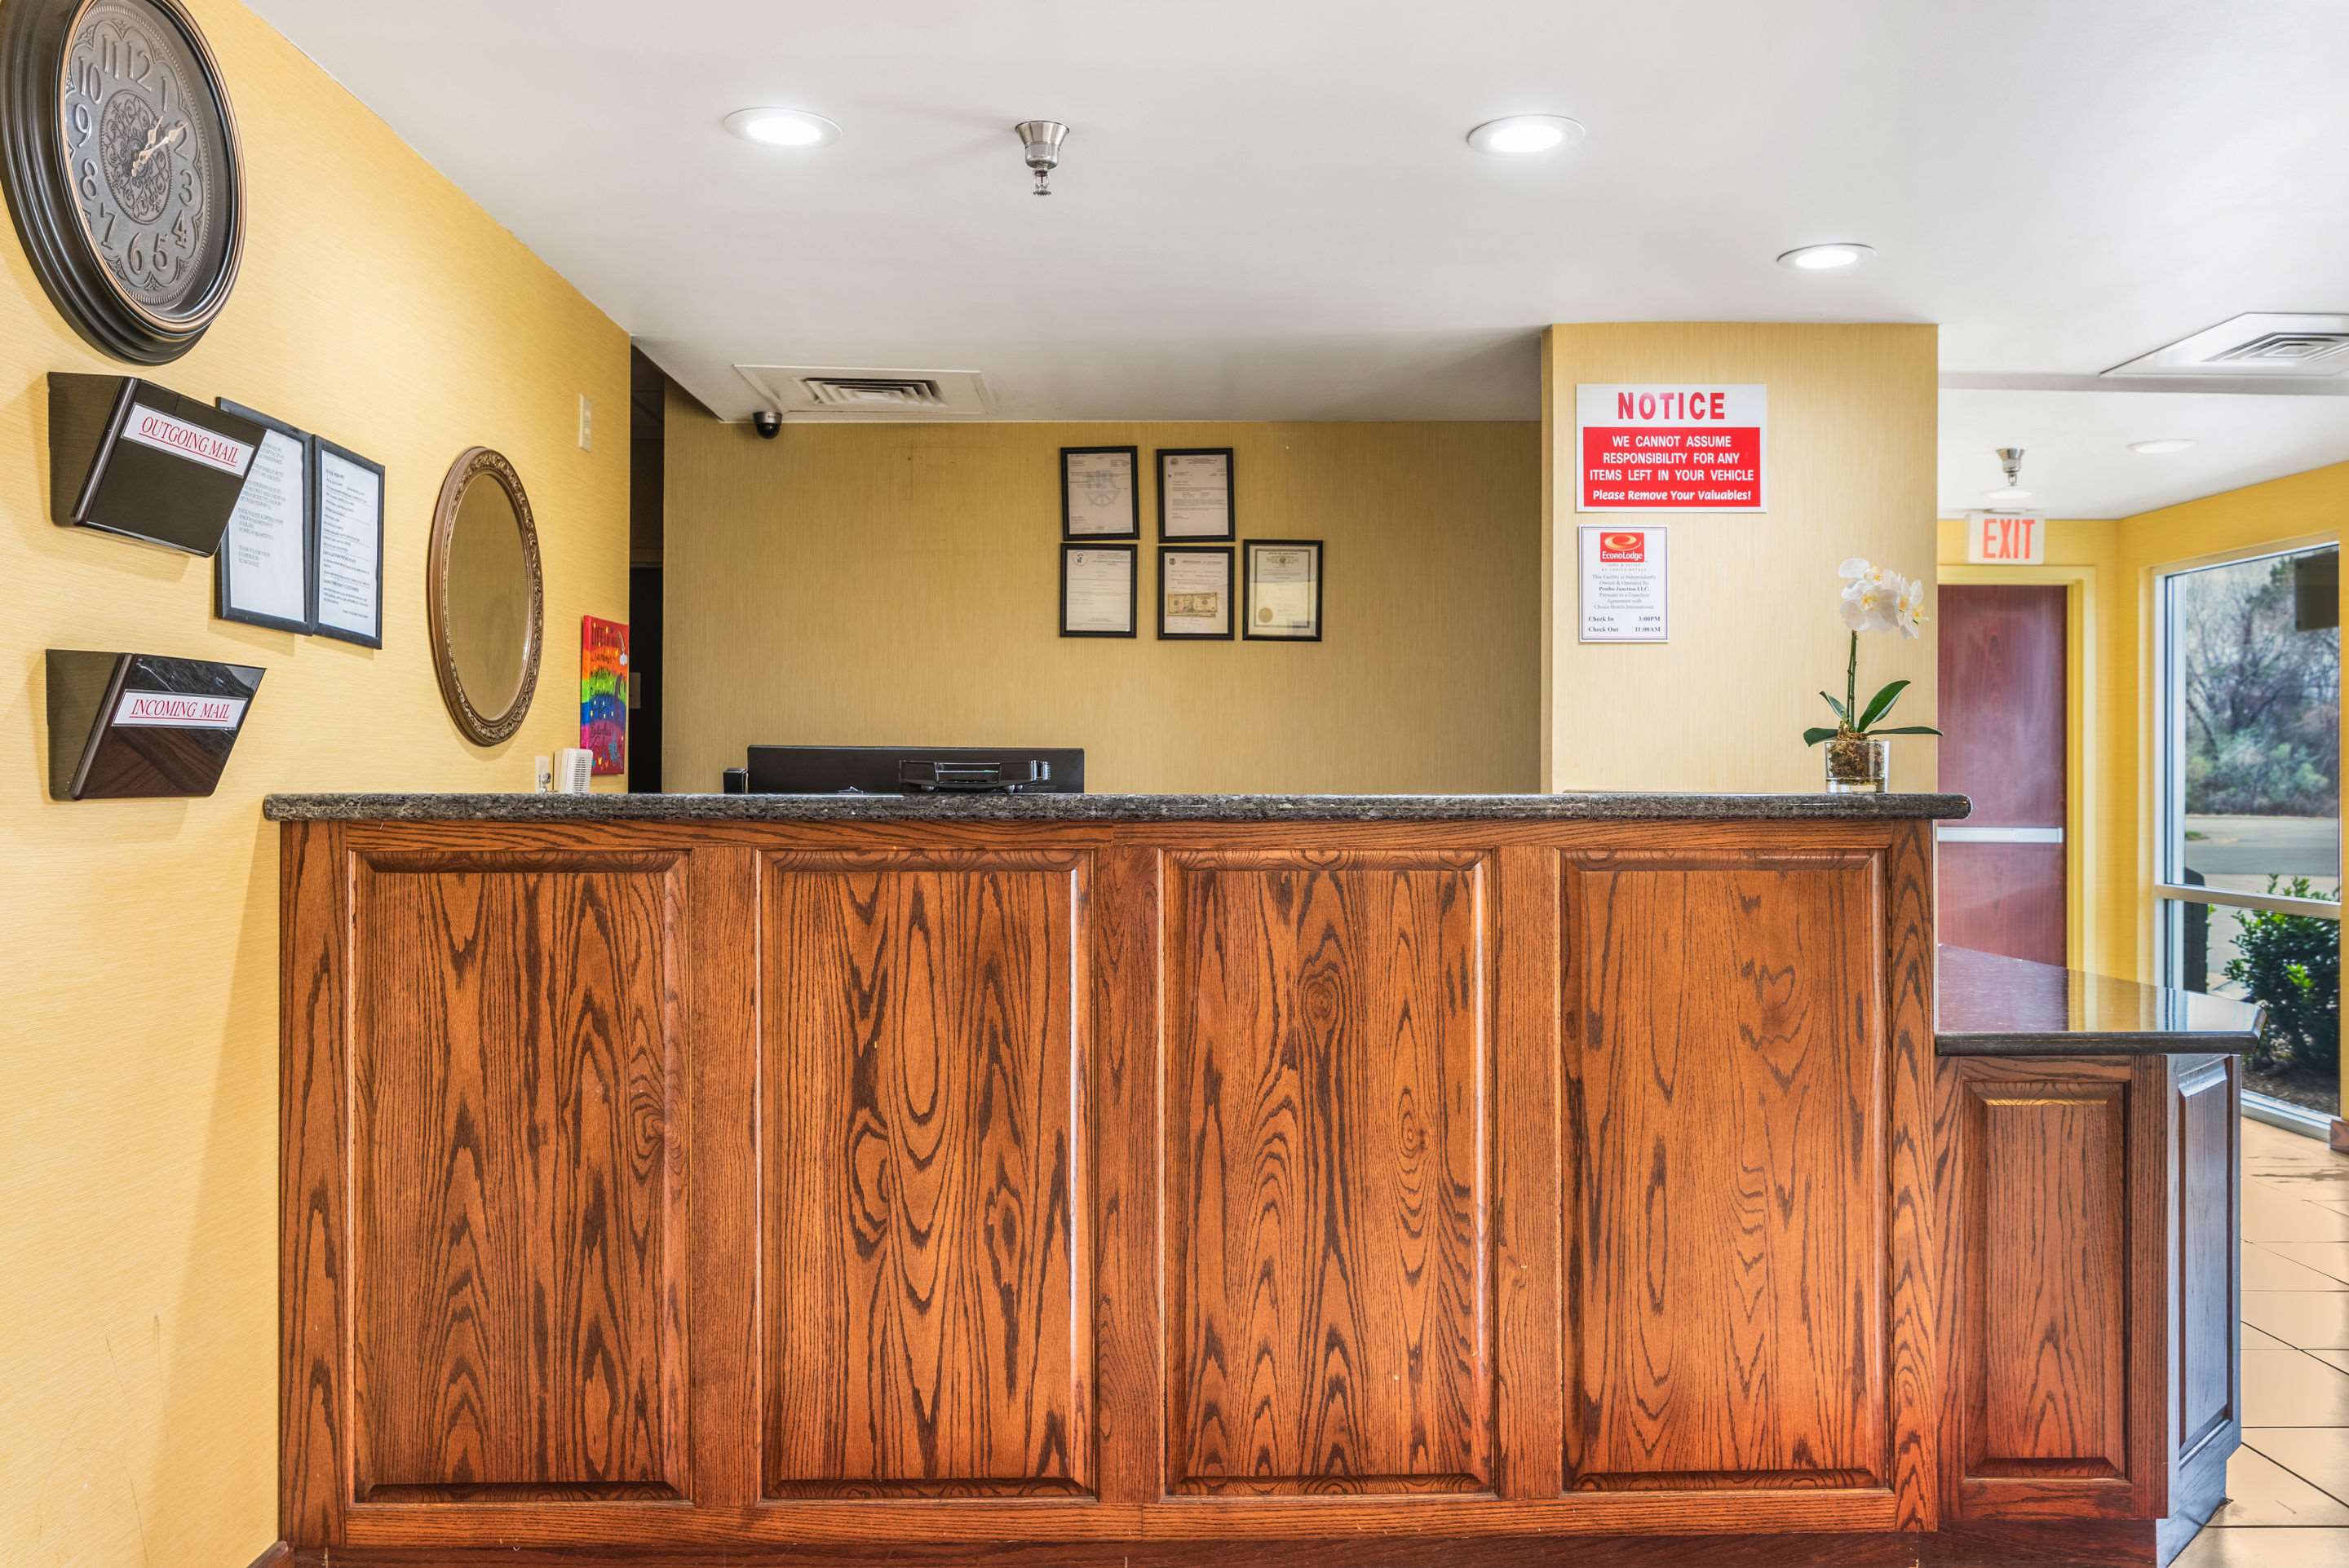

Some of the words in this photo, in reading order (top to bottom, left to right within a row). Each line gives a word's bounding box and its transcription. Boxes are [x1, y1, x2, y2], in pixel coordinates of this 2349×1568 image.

[102, 34, 120, 80] 11
[127, 42, 153, 93] 12
[78, 56, 104, 105] 10
[161, 75, 169, 113] 1
[74, 104, 92, 148] 9
[174, 119, 188, 161] 2
[81, 158, 99, 201] 8
[178, 169, 193, 207] 3
[100, 202, 118, 250] 7
[171, 209, 188, 249] 4
[128, 232, 144, 275] 6
[153, 233, 169, 272] 5
[1617, 392, 1725, 420] NOTICE
[142, 417, 210, 452] OUTGOING
[209, 440, 239, 463] MAIL
[1603, 453, 1688, 464] RESPONSIBILITY
[1693, 453, 1714, 464] FOR
[1717, 453, 1740, 464] ANY
[1612, 435, 1630, 447] WE
[1635, 435, 1681, 447] CANNOT
[1686, 435, 1732, 447] ASSUME
[1590, 470, 1621, 481] ITEMS
[1628, 470, 1652, 481] LEFT
[1658, 470, 1669, 481] IN
[1674, 470, 1704, 481] YOUR
[1710, 470, 1754, 481] VEHICLE
[1593, 489, 1625, 501] Please
[1628, 490, 1668, 501] Remove
[1670, 490, 1695, 501] Your
[1697, 490, 1751, 501] Valuables!
[1983, 519, 2036, 559] EXIT
[131, 699, 198, 717] INCOMING
[200, 702, 231, 718] MAIL
